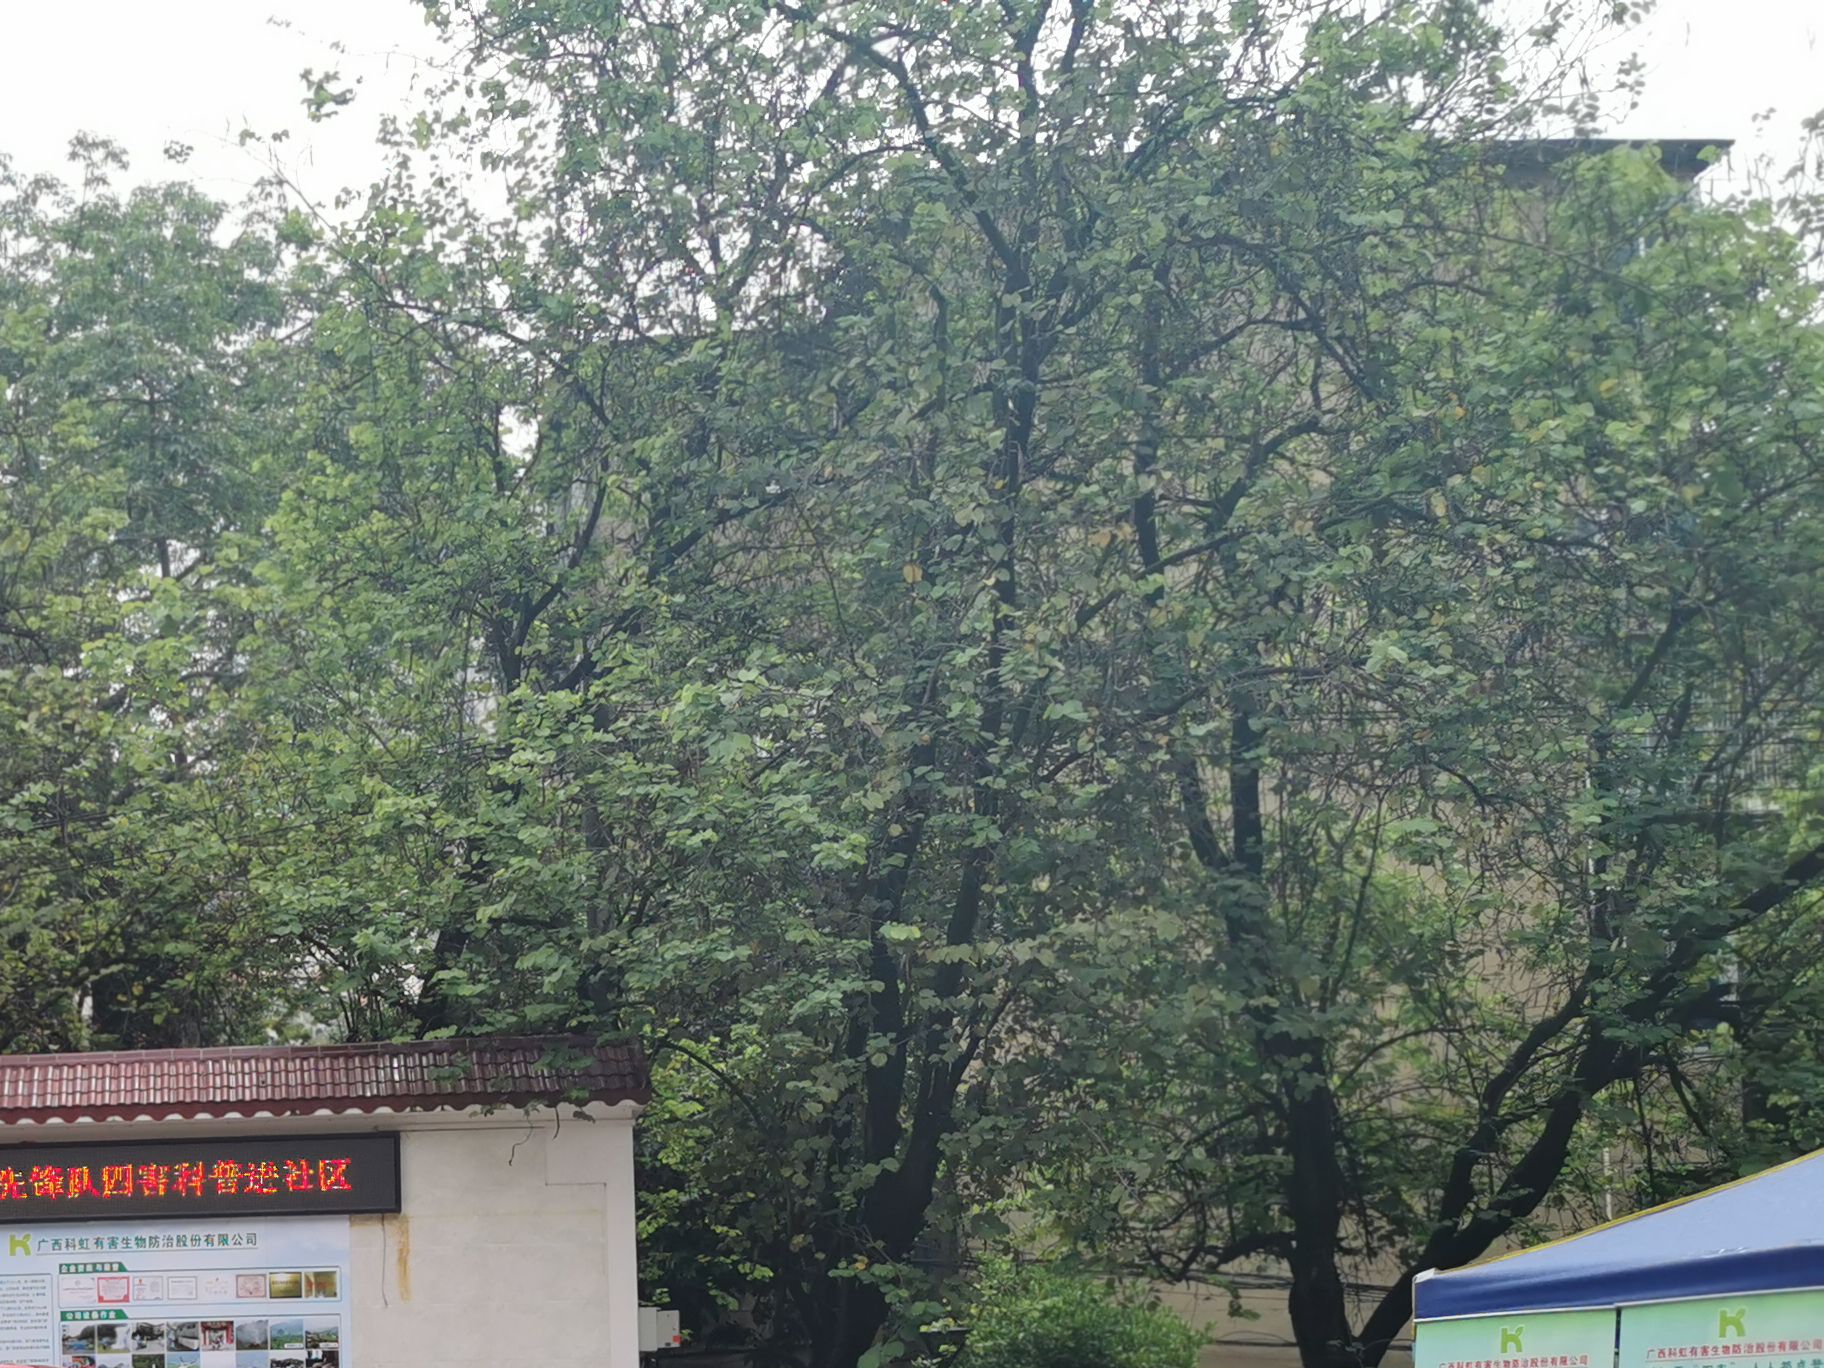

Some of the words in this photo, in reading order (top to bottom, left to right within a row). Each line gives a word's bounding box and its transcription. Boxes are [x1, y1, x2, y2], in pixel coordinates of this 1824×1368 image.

[37, 1232, 258, 1252] 广西科虹有害生物防治股份有限公司
[1647, 1339, 1823, 1359] 广西科虹有害生物防治股份有限公司
